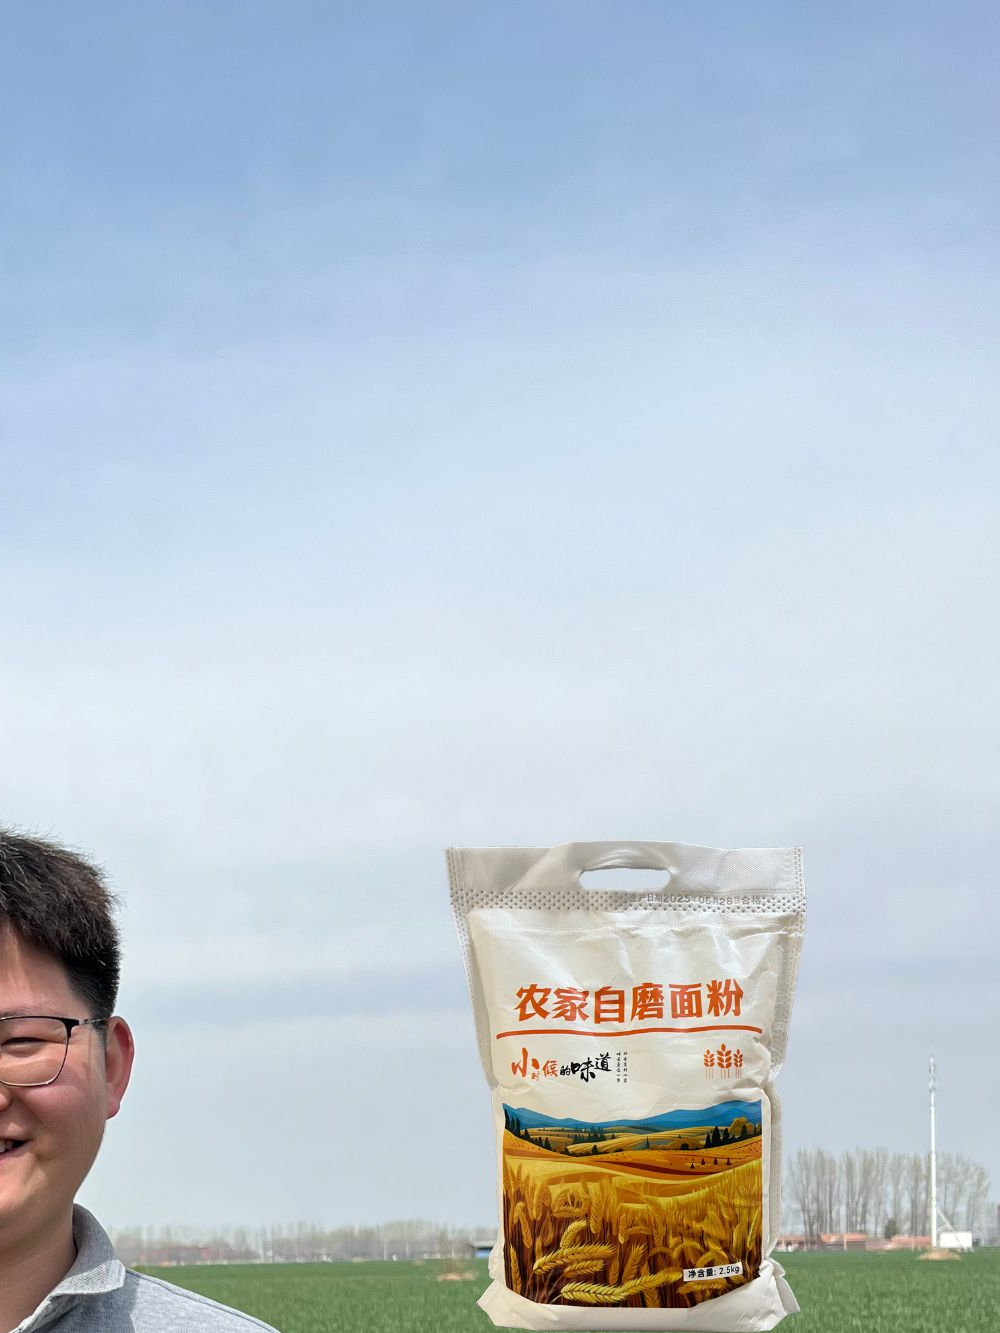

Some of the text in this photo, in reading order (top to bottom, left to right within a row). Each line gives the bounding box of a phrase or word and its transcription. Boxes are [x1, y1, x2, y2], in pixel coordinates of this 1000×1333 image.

[514, 978, 744, 1024] 农家自磨面粉
[511, 1047, 612, 1082] 小时候的味道
